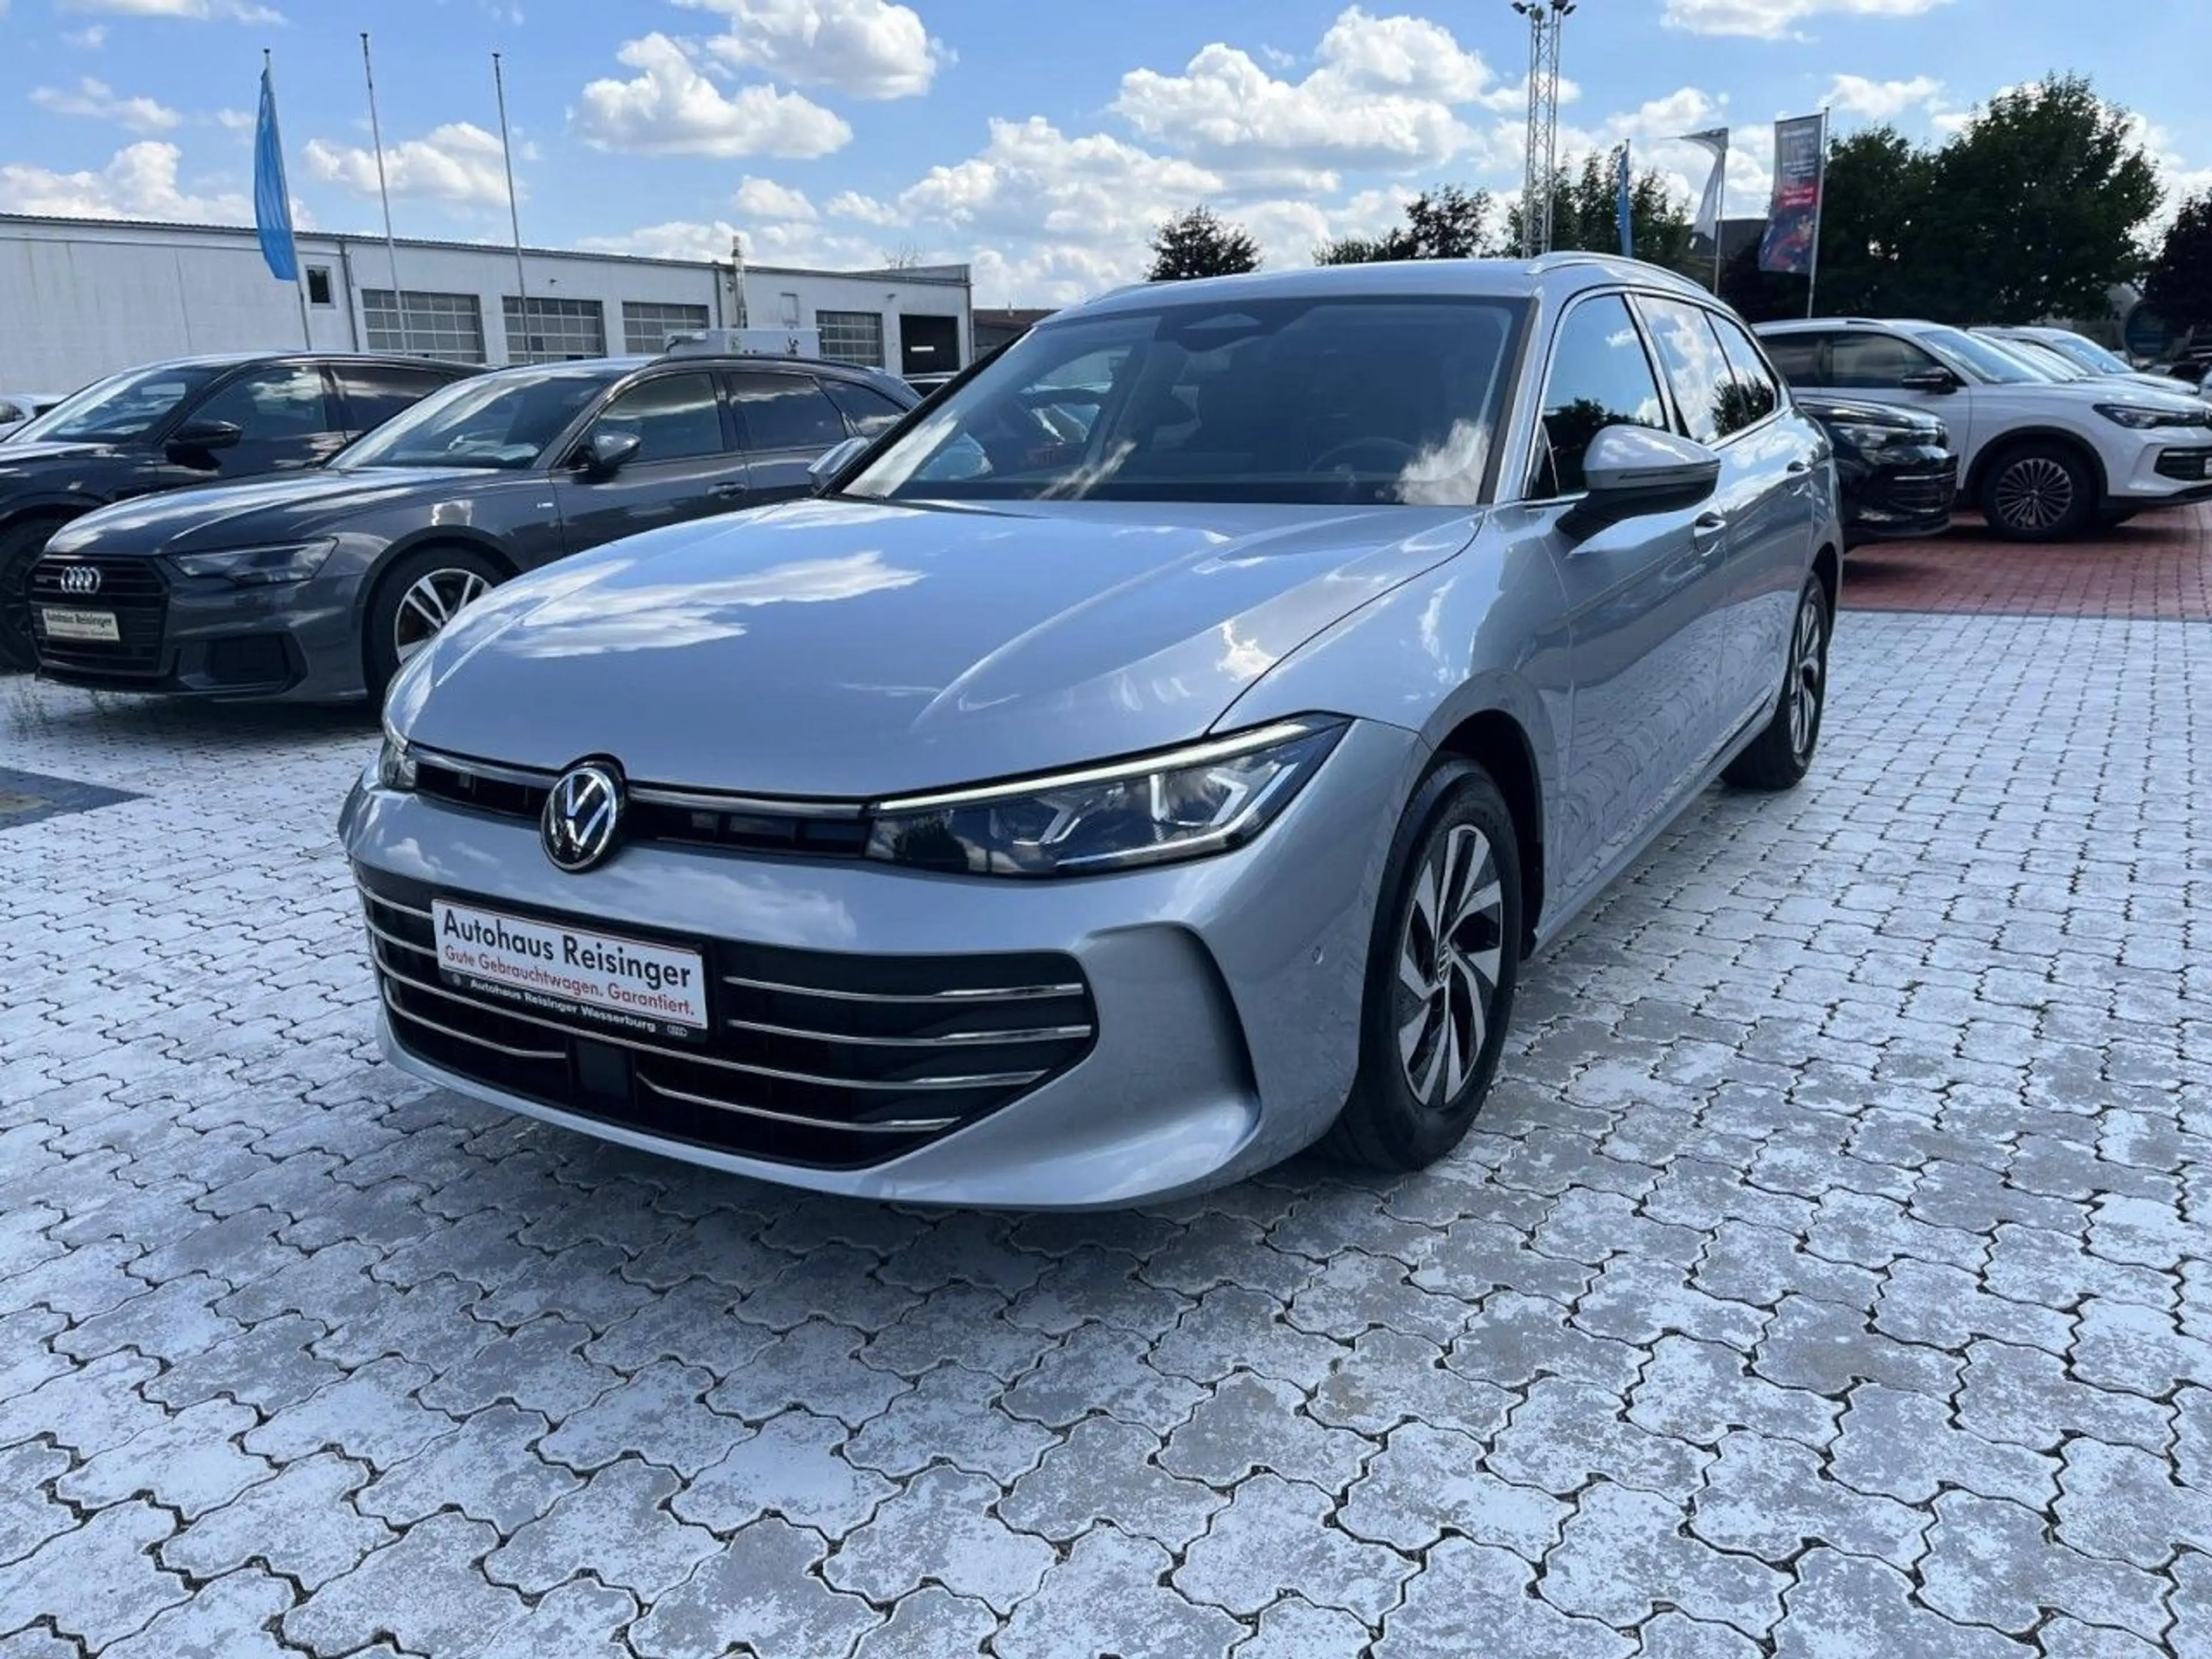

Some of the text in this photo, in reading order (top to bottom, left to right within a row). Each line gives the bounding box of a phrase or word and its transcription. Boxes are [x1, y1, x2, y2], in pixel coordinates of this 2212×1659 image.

[443, 908, 691, 990] Autohaus Reisinger
[445, 945, 695, 1016] Gute Gebrauchtwagen. Garantiert.
